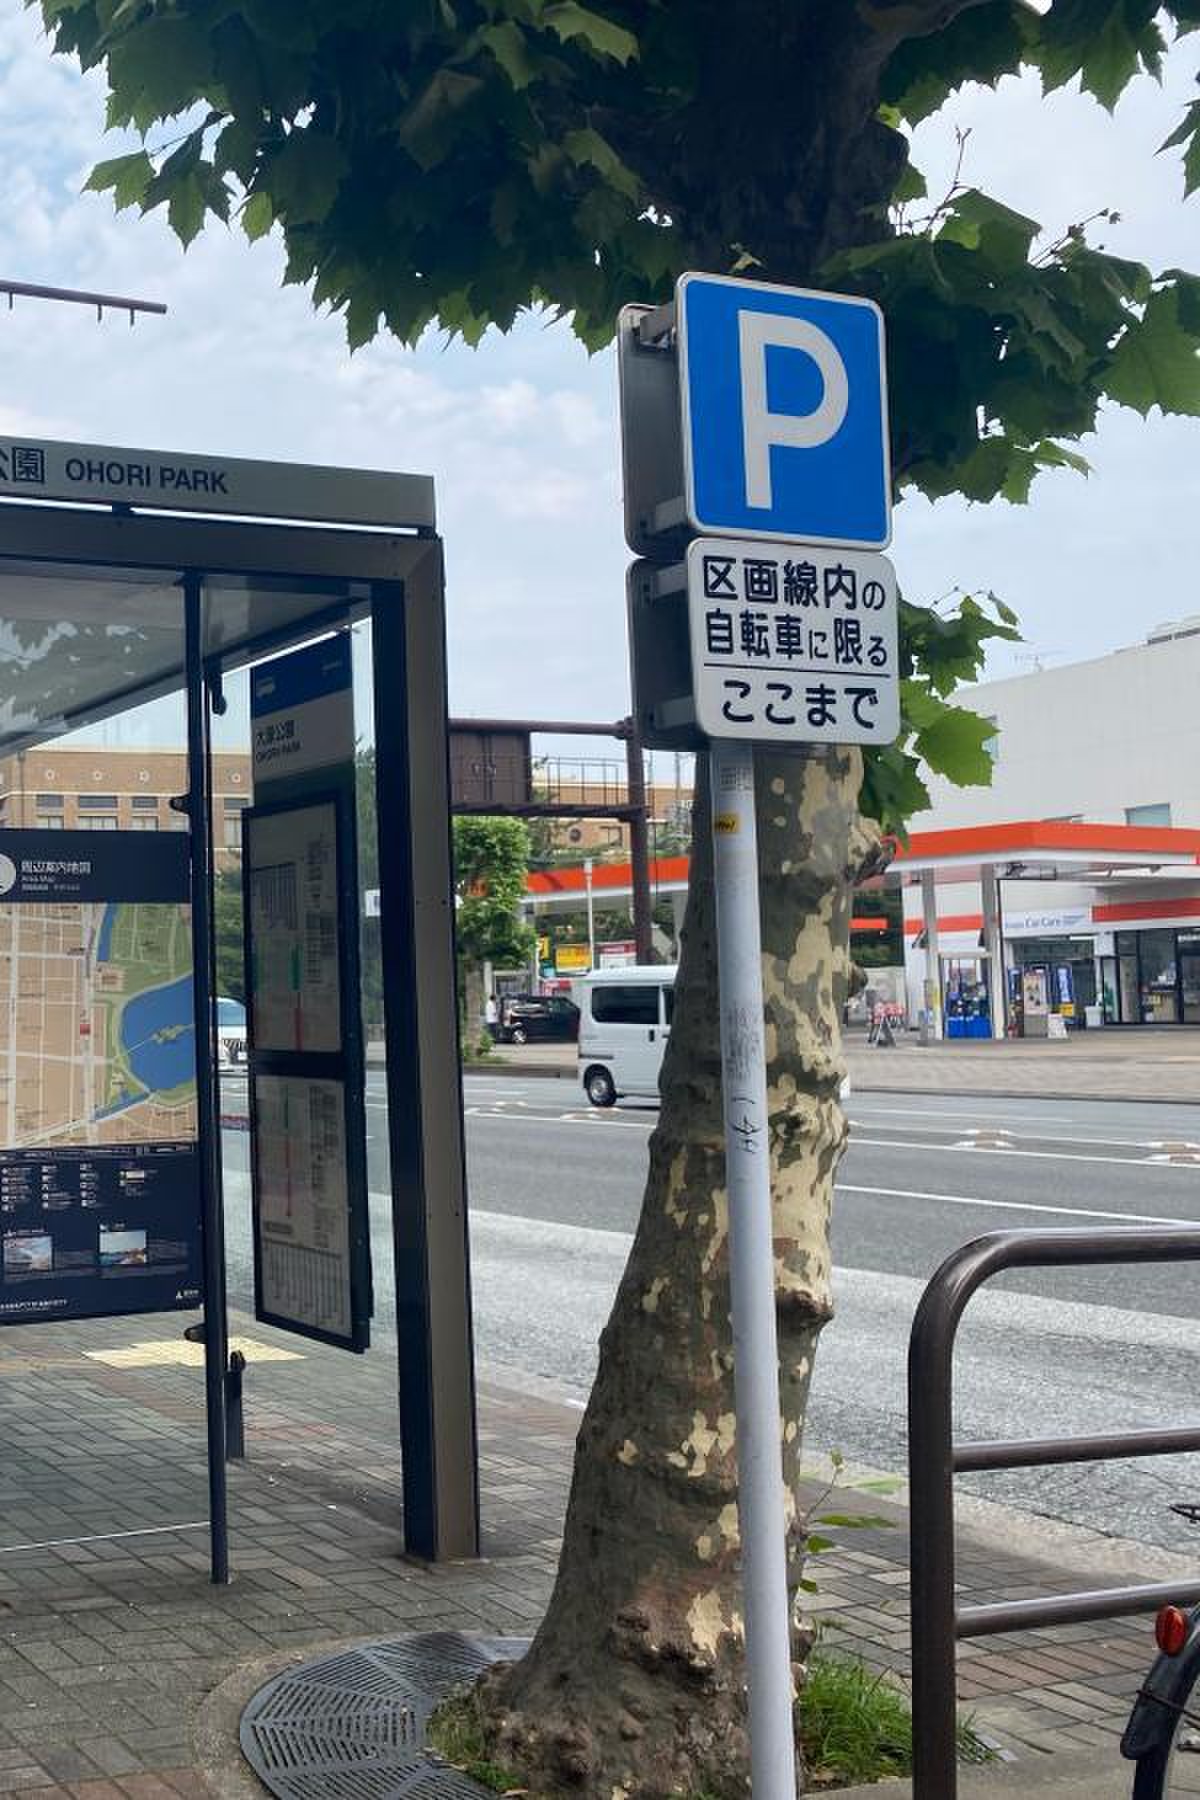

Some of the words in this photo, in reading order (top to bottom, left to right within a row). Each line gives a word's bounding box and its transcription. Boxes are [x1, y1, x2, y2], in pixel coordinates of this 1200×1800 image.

[738, 309, 849, 511] P
[64, 457, 151, 488] OHORI
[159, 465, 229, 495] PARK
[702, 555, 885, 612] 区画線内の
[704, 607, 889, 668] 自転車に限る
[721, 677, 879, 730] ここまで
